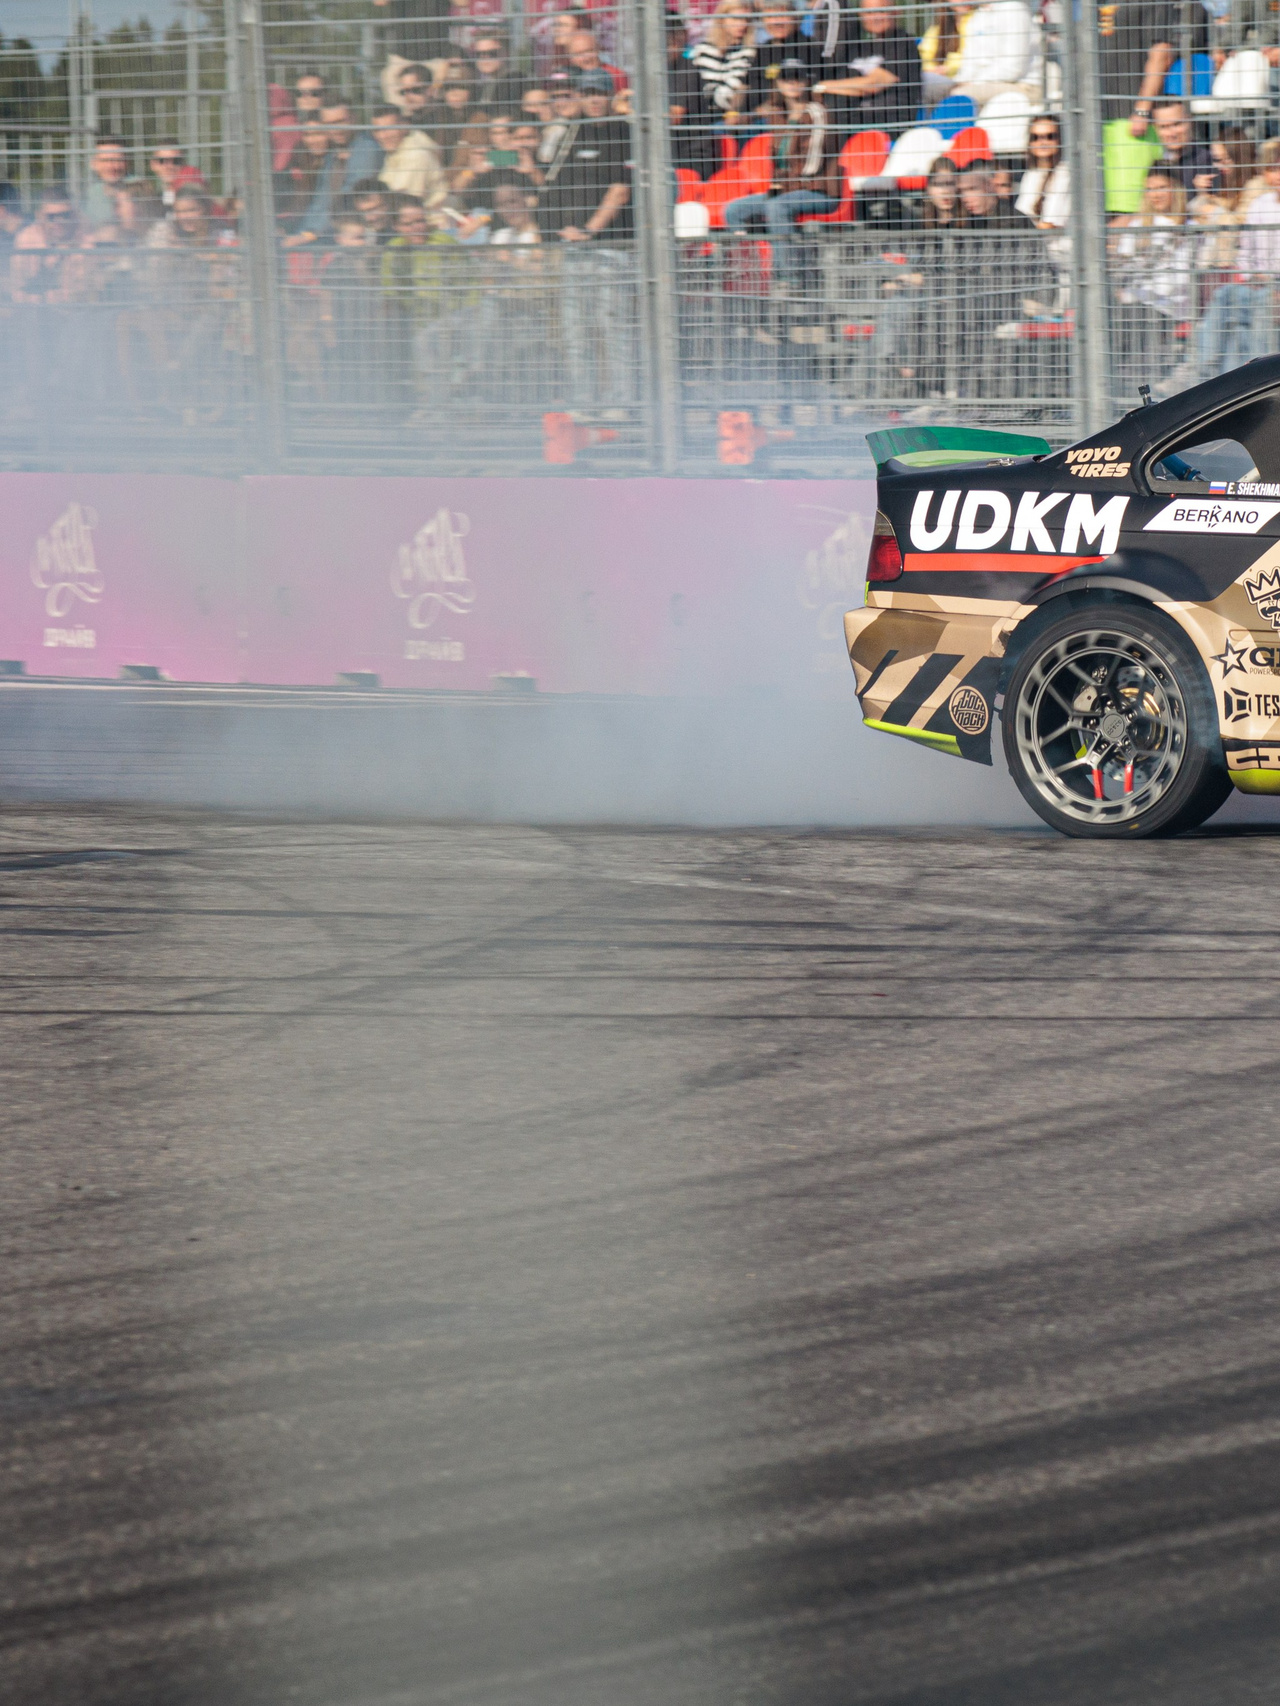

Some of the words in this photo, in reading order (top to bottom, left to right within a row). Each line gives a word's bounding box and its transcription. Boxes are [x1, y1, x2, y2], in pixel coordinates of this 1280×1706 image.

[1065, 446, 1121, 463] YOYO
[1069, 462, 1131, 478] TIRES
[1227, 484, 1236, 495] E.
[909, 489, 1131, 555] UDKM
[1173, 507, 1259, 525] BERKANO
